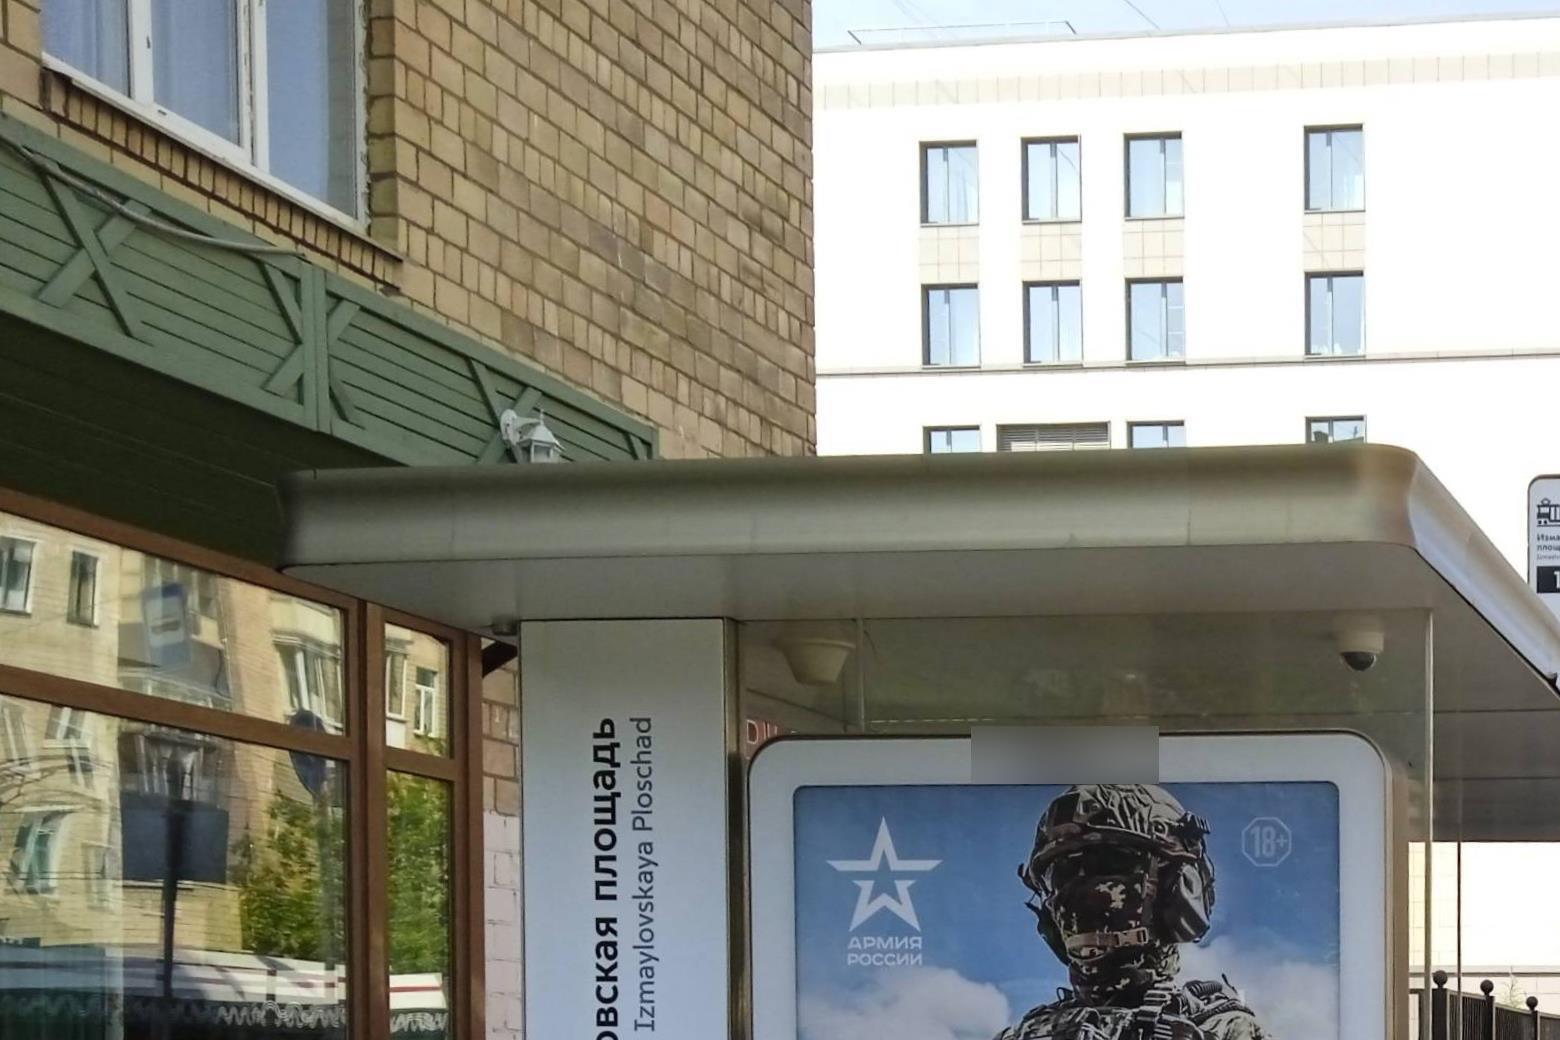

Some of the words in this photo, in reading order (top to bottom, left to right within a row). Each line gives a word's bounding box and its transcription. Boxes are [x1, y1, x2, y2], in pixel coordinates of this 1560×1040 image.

[592, 717, 622, 902] площадь
[629, 716, 656, 833] Ploschad
[1249, 825, 1288, 858] 18+
[631, 841, 660, 1033] Izmaylovskaya
[847, 936, 923, 950] АРМИЯ
[847, 953, 923, 967] РОССИИ
